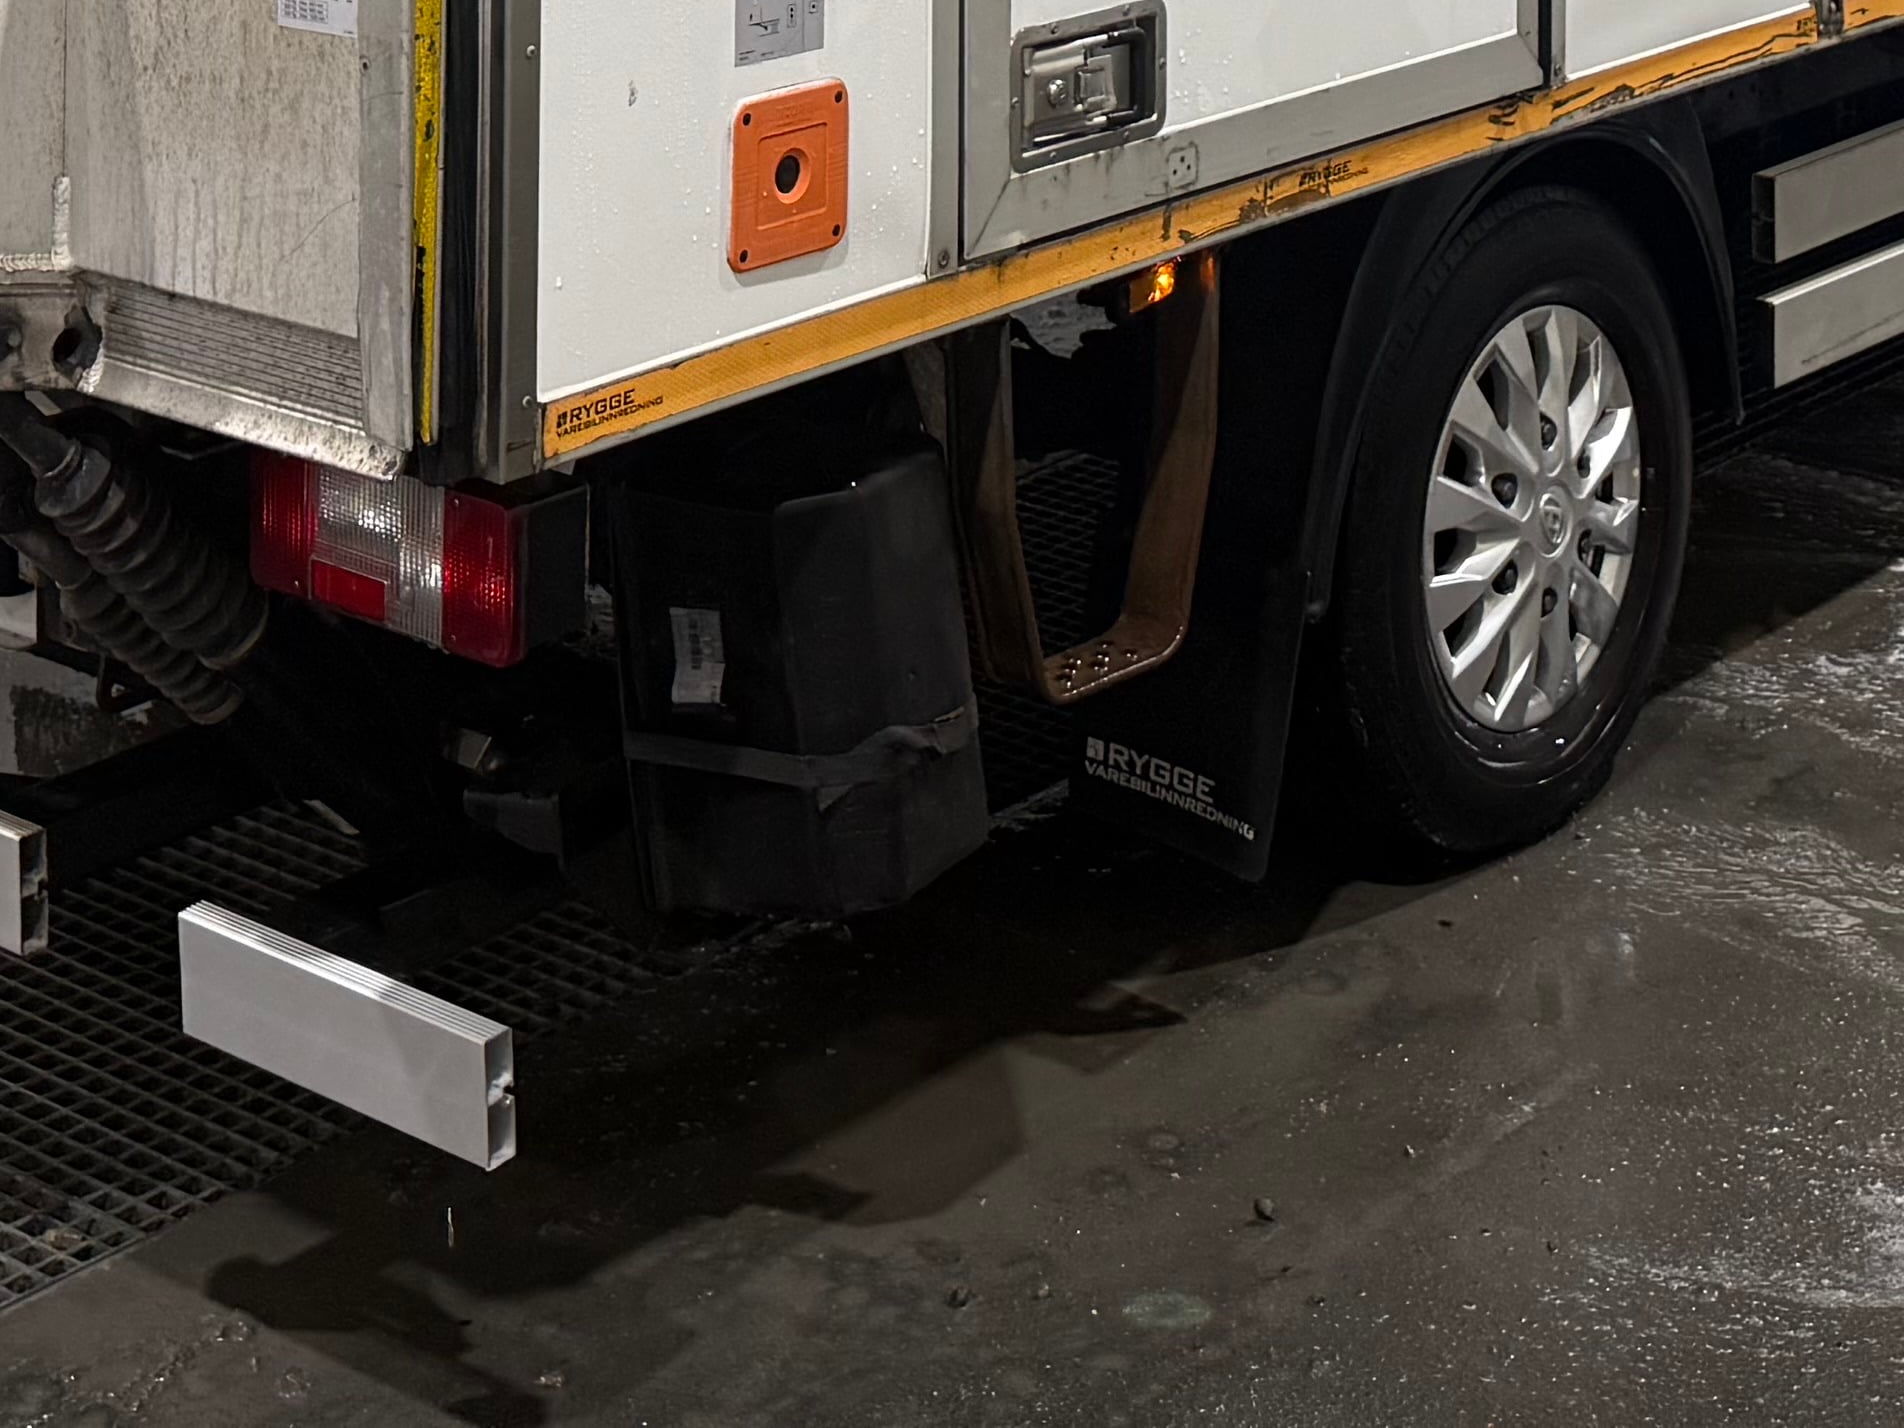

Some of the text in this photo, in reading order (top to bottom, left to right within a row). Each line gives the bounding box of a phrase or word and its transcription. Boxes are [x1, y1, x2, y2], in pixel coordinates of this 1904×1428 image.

[556, 395, 664, 439] VAREBILINNREDNING
[569, 388, 636, 423] RYGGE
[1108, 742, 1216, 803] RYGGE
[1084, 759, 1257, 841] VAREBILINNREDNING
